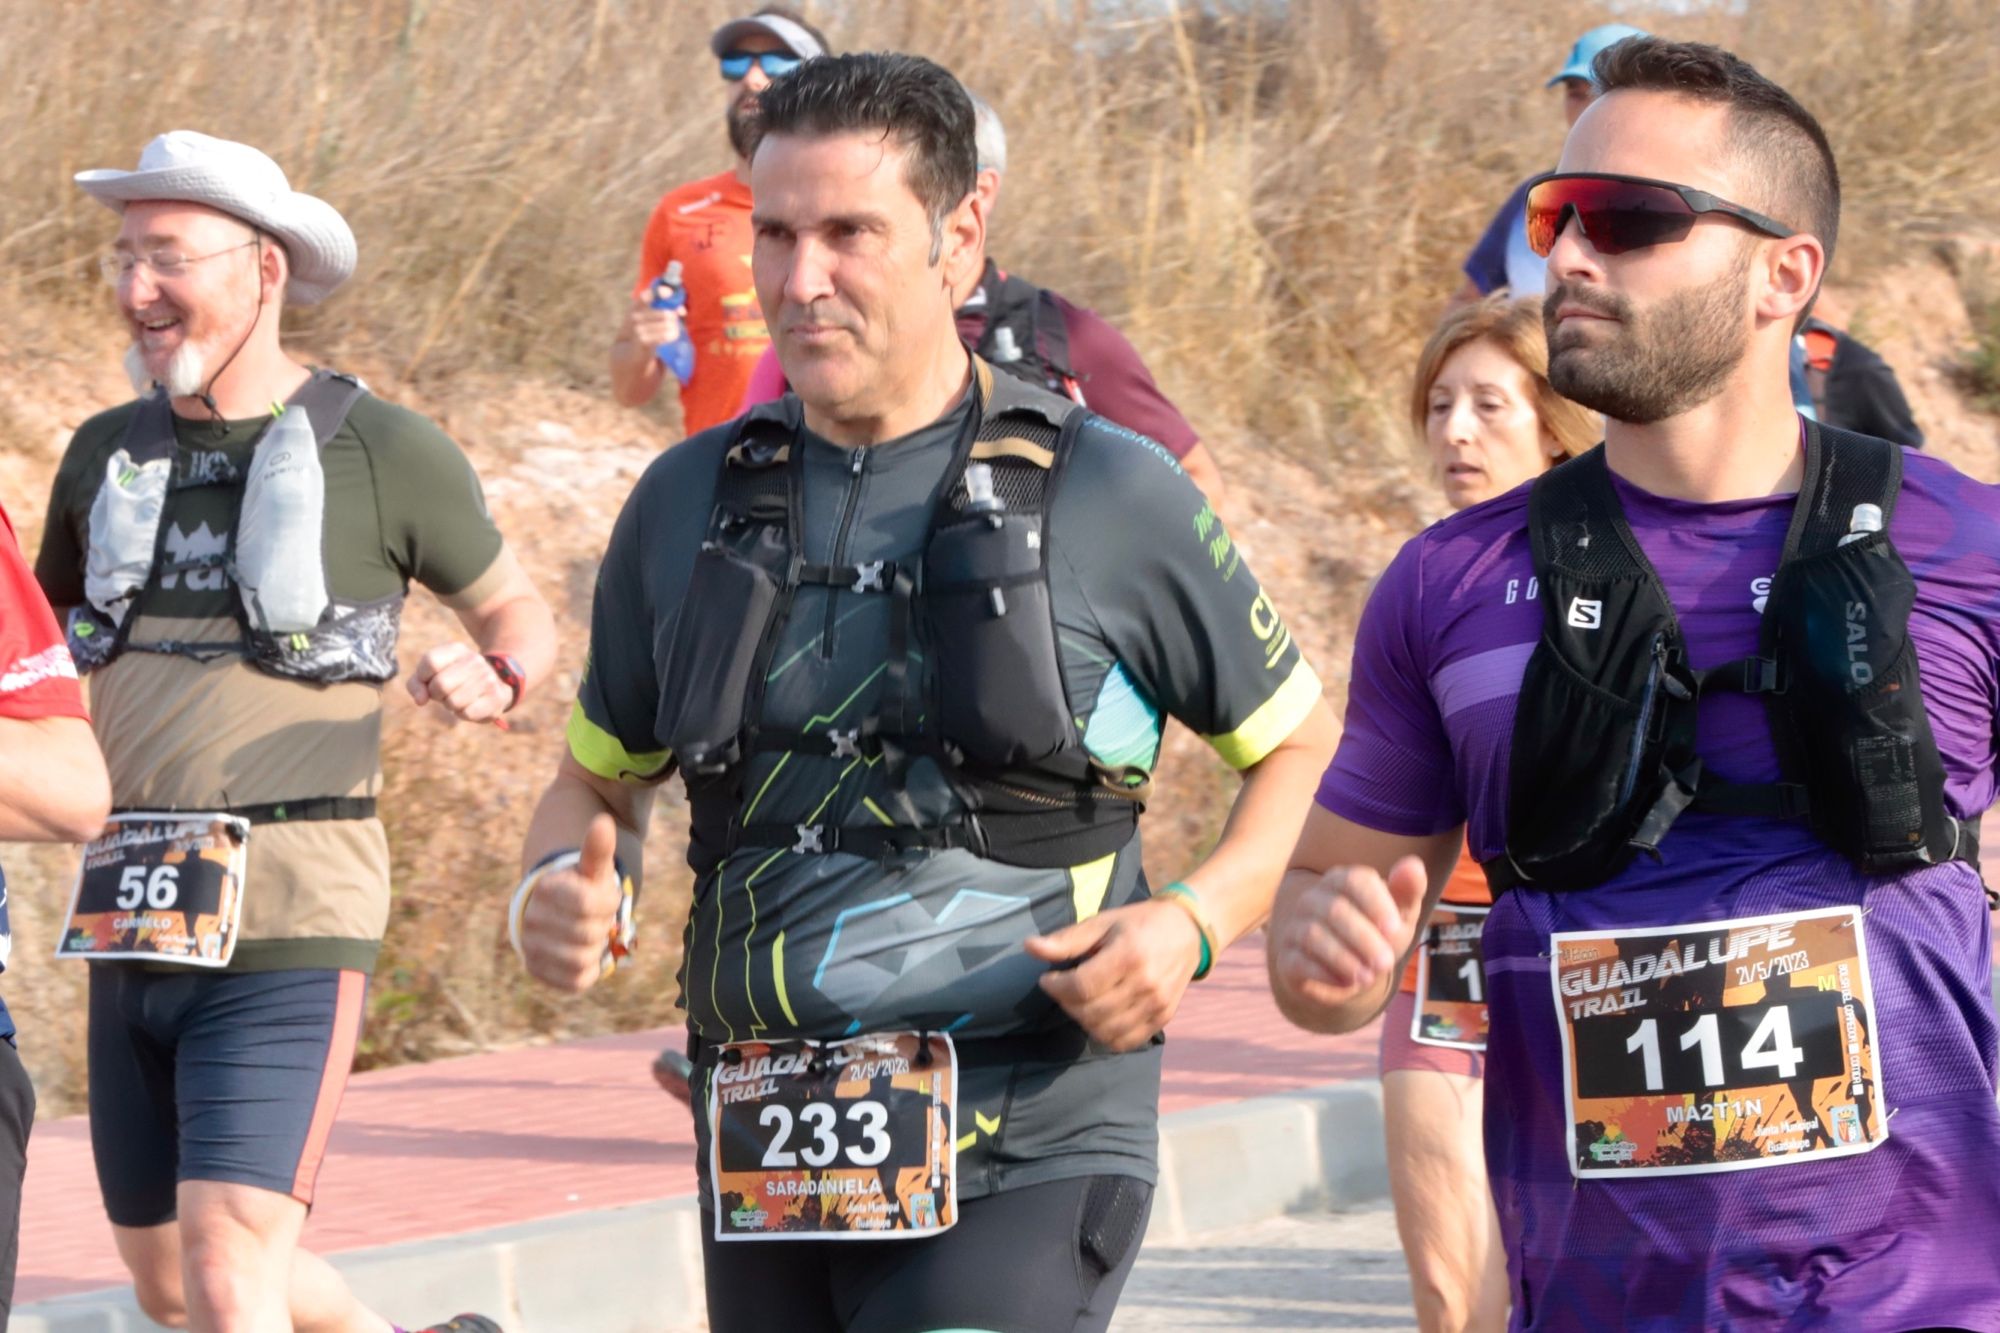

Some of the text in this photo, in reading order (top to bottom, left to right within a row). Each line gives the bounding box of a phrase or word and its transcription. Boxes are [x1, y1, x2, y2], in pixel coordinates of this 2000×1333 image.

[116, 864, 180, 910] 56
[112, 917, 172, 930] CARMELO
[1560, 920, 1798, 998] GUADALUPE
[1736, 950, 1810, 987] 21/5/2023
[1817, 974, 1837, 992] M
[1569, 986, 1648, 1021] TRAIL
[1626, 1004, 1804, 1091] 114
[850, 1057, 909, 1081] 21/5/2023
[721, 1077, 780, 1105] TRAIL
[1665, 1098, 1763, 1123] MA2T1N
[759, 1100, 892, 1168] 233
[766, 1177, 883, 1197] SARADANIELA
